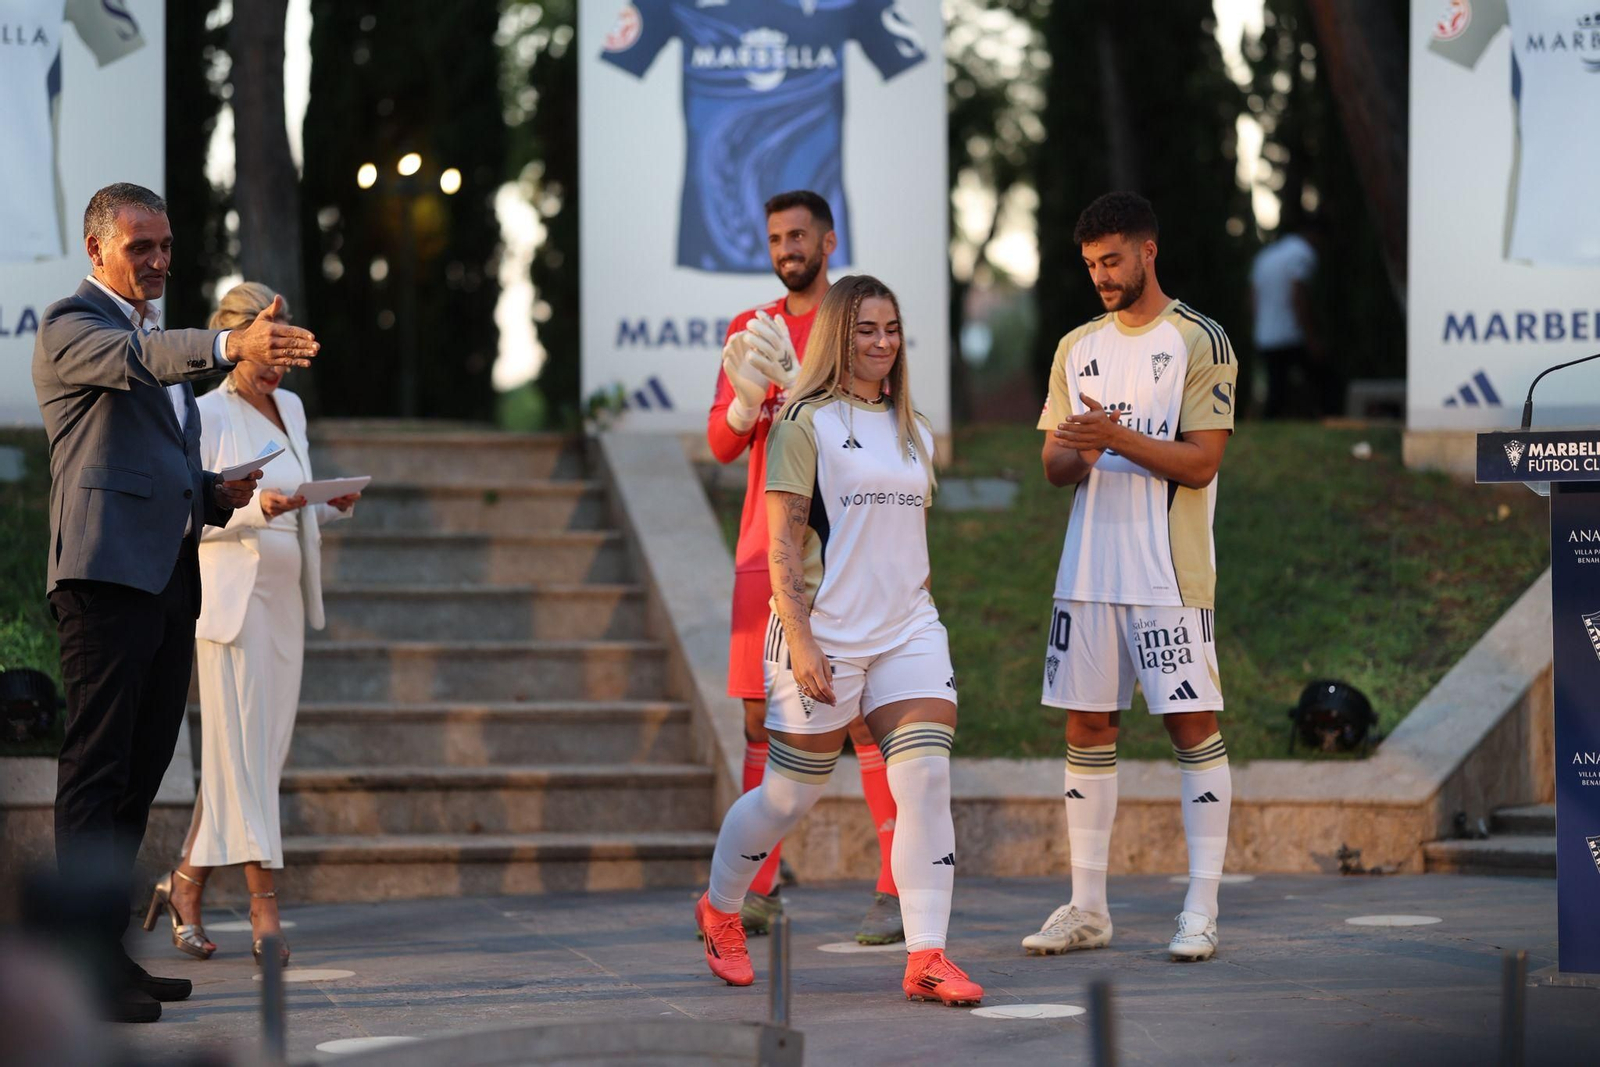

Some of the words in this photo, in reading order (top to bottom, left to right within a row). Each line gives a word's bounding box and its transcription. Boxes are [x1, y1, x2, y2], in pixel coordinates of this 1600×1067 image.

[691, 45, 838, 69] MARBELLA
[1528, 455, 1580, 472] FÚTBOL
[1583, 458, 1600, 471] CL
[1568, 529, 1600, 543] ANA
[1049, 606, 1072, 652] 10
[1132, 618, 1157, 631] sabor
[1142, 616, 1192, 649] má
[1136, 642, 1195, 675] laga
